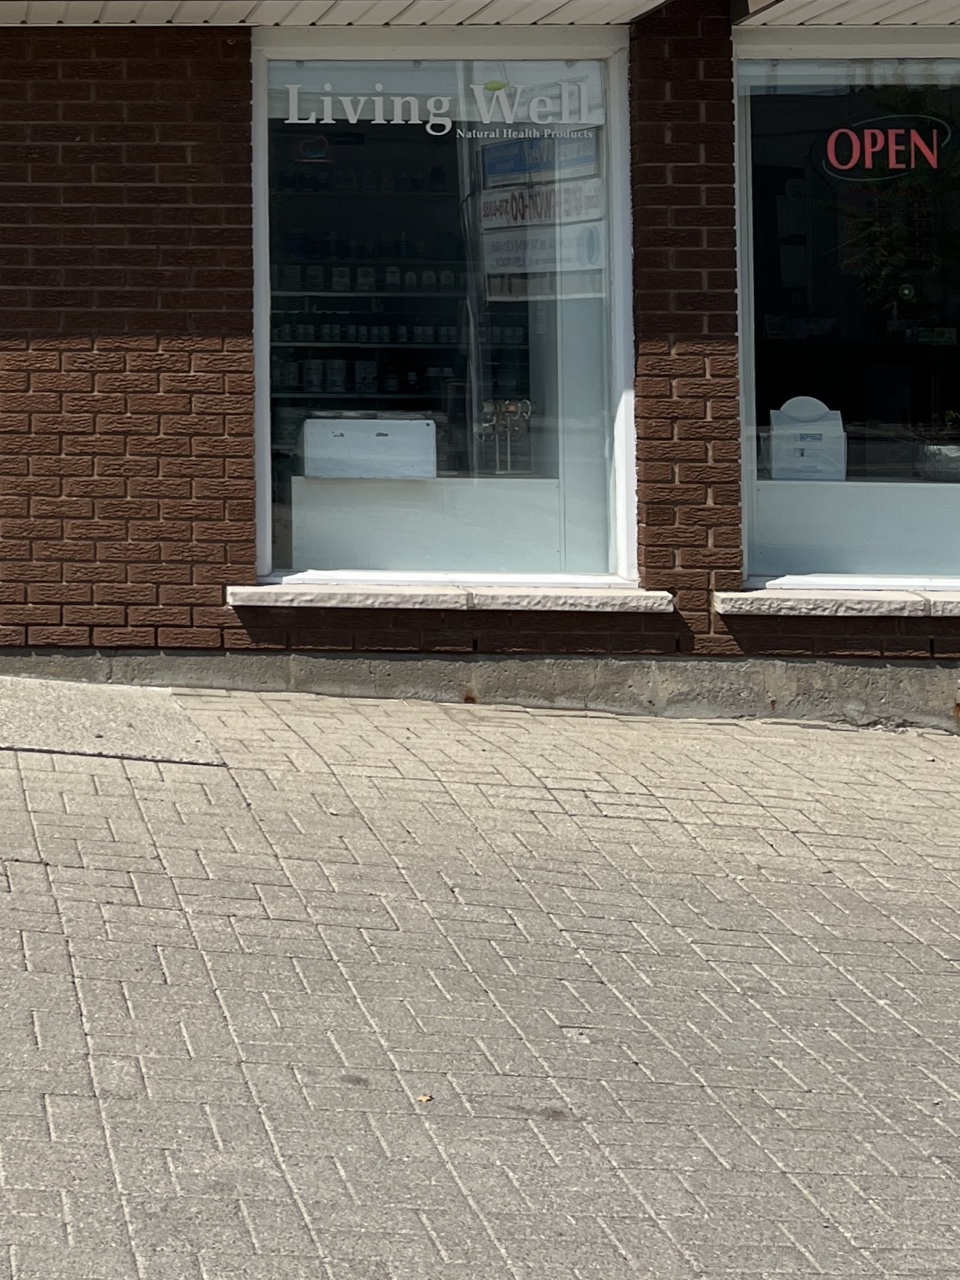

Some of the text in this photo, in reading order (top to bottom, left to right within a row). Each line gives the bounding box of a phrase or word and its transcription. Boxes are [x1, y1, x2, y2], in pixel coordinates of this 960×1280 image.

[284, 80, 590, 136] Living Well
[456, 127, 594, 139] Natural Health Products
[826, 128, 938, 170] OPEN
